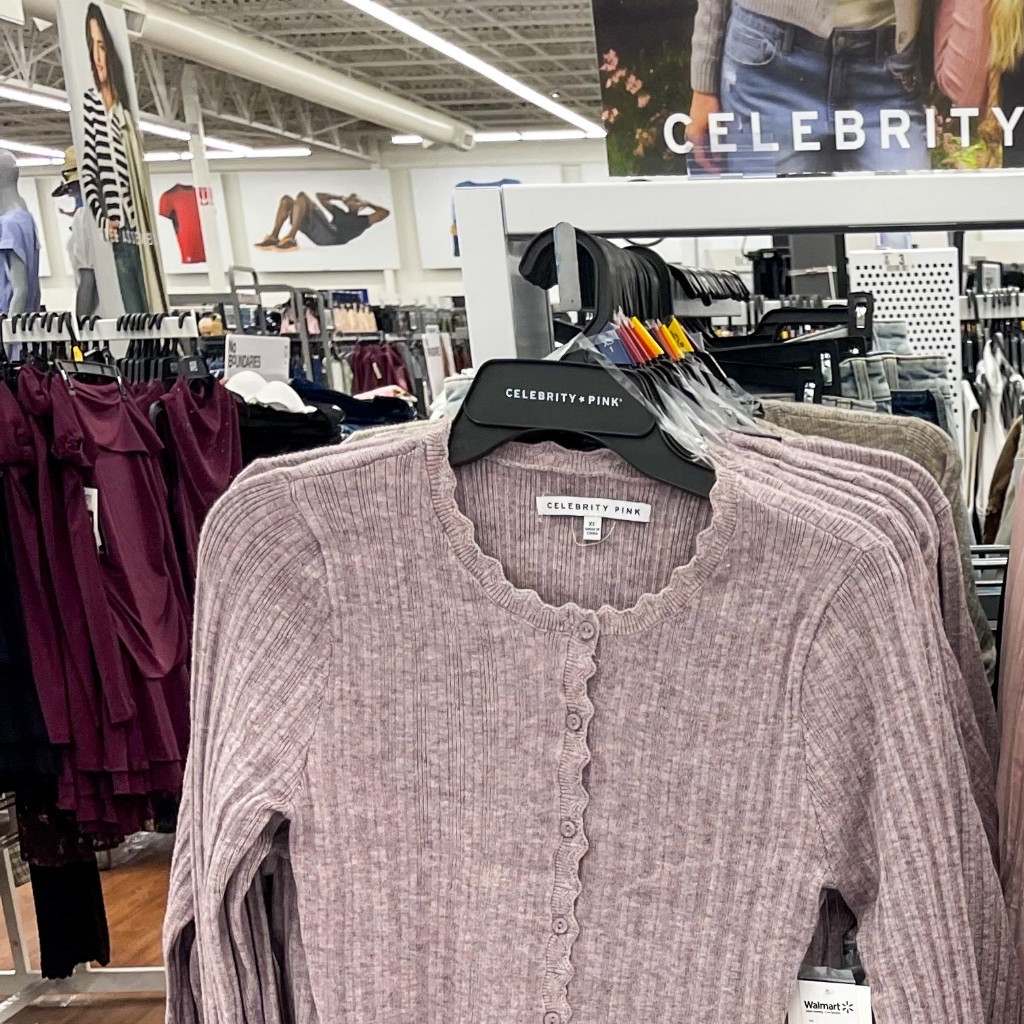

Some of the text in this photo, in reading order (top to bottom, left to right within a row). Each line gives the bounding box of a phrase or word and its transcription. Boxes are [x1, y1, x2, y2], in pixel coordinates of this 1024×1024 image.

[663, 106, 1024, 154] CELEBRITY
[505, 388, 576, 403] CELEBRITY
[546, 502, 641, 516] CELEBRITY PINK
[803, 1000, 841, 1011] Walmart
